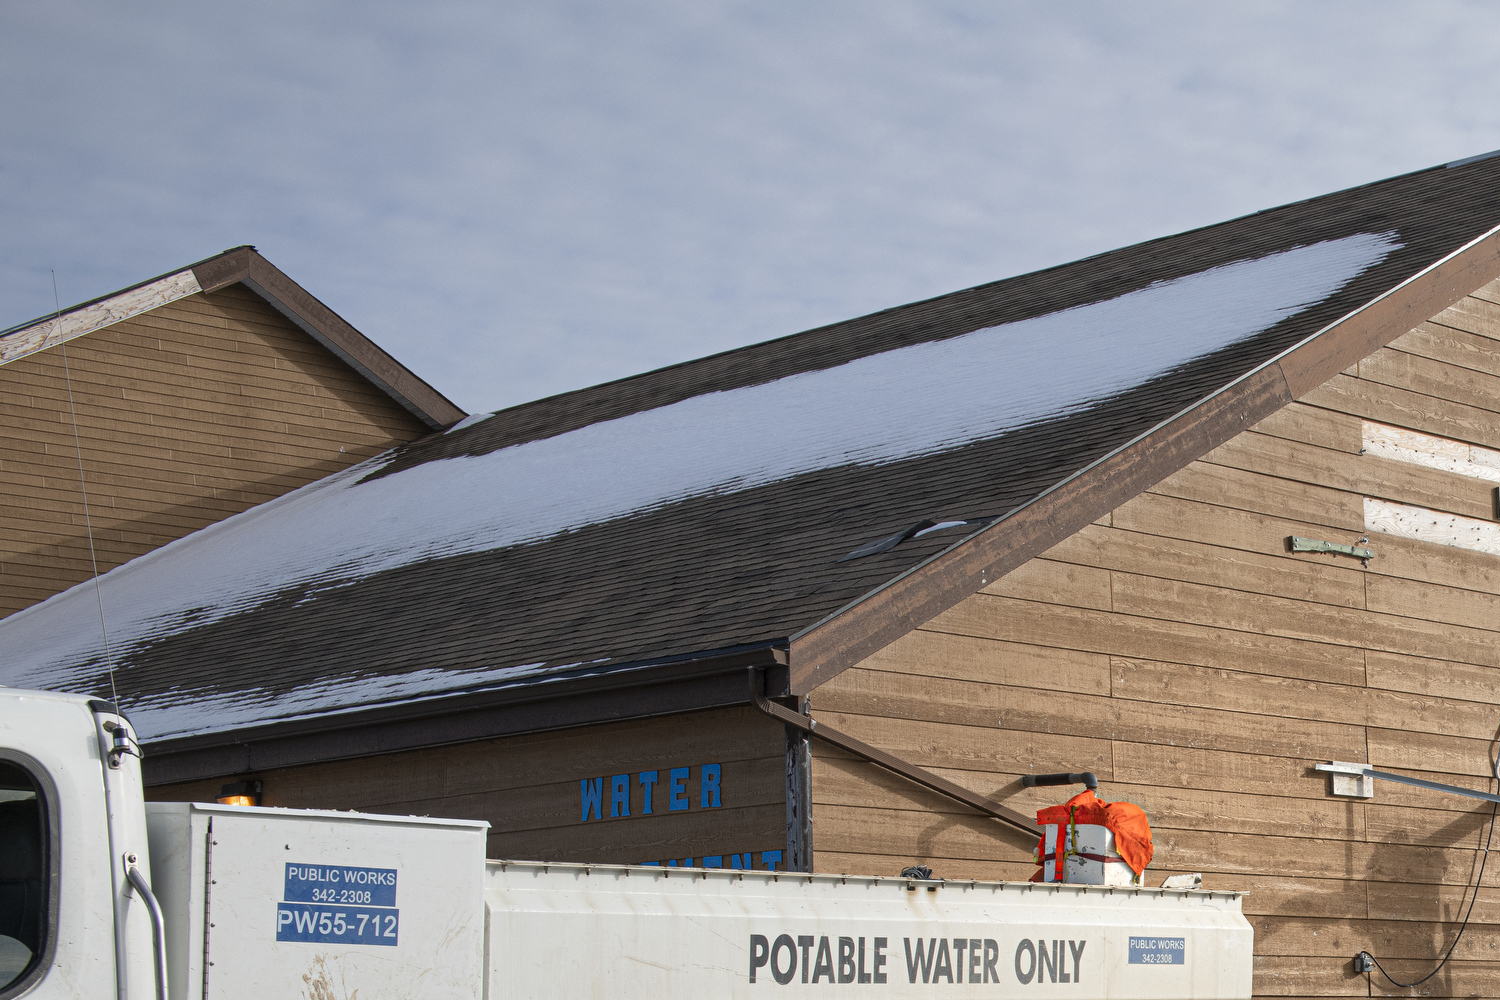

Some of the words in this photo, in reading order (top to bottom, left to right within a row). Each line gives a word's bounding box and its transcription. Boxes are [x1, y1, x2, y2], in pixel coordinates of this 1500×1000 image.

[580, 763, 722, 821] WATER
[288, 867, 340, 882] PUBLIC
[343, 870, 396, 886] WORKS
[312, 888, 371, 903] 342-2308
[277, 909, 397, 937] PW55-712
[1130, 939, 1156, 949] PUBLIC
[1158, 940, 1184, 950] WORKS
[749, 933, 888, 985] POTABLE
[903, 937, 1001, 984] WATER
[1014, 938, 1087, 985] ONLY
[1142, 953, 1172, 963] 342-2308
